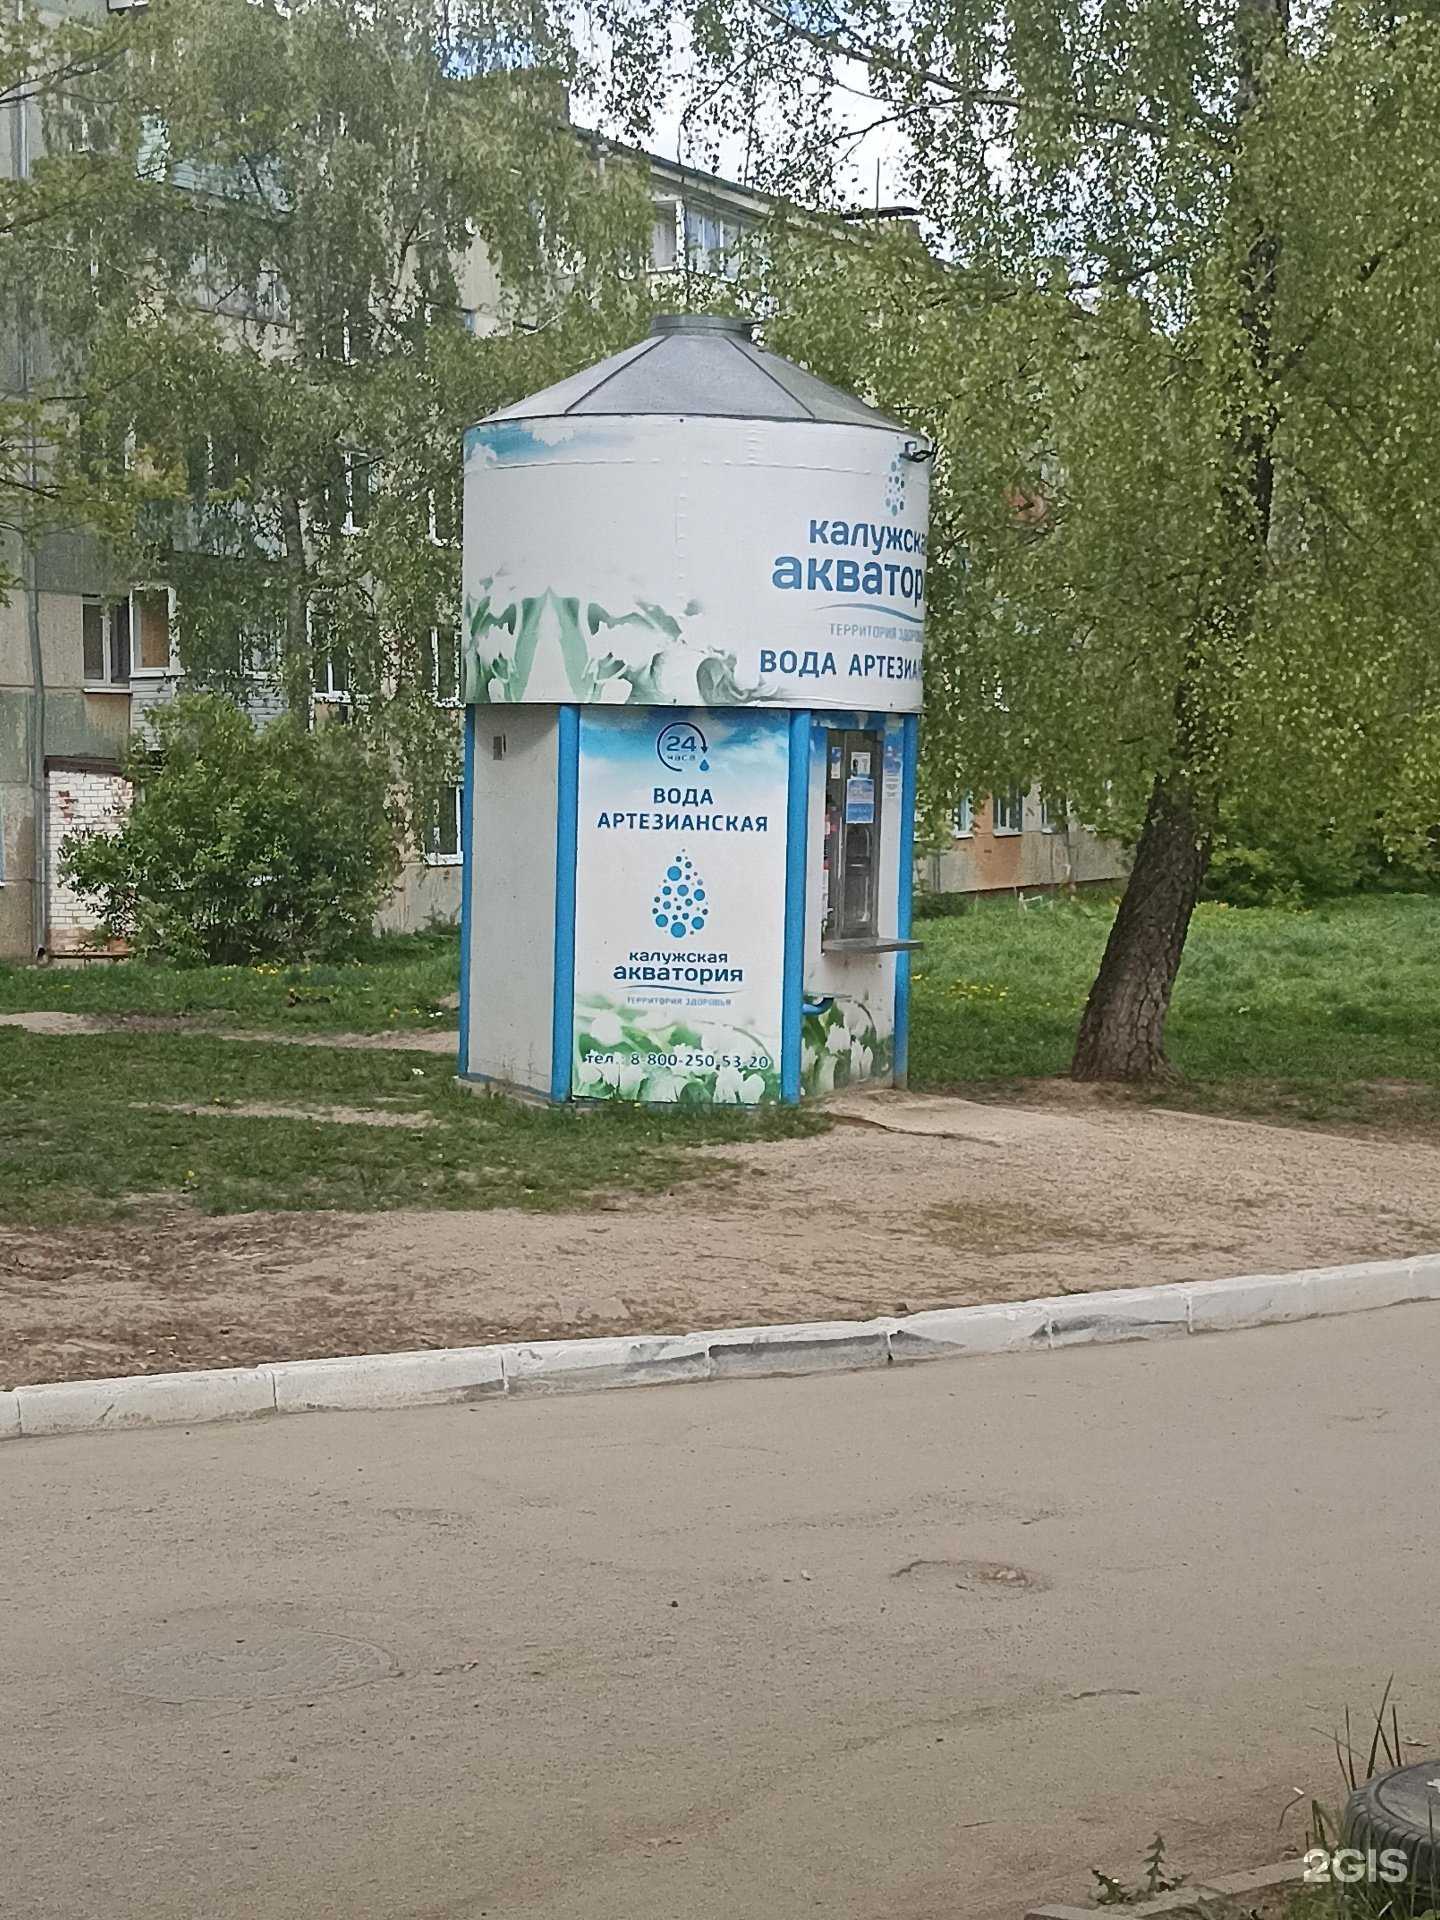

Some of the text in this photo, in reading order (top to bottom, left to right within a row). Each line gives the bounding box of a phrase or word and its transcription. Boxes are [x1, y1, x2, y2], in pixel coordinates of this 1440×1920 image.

[760, 649, 837, 678] ВОДА
[666, 735, 697, 752] 24
[653, 787, 714, 807] ВОДА
[597, 812, 768, 832] АРТЕЗИАНСКАЯ
[629, 951, 728, 965] калужская
[613, 965, 743, 985] акватория
